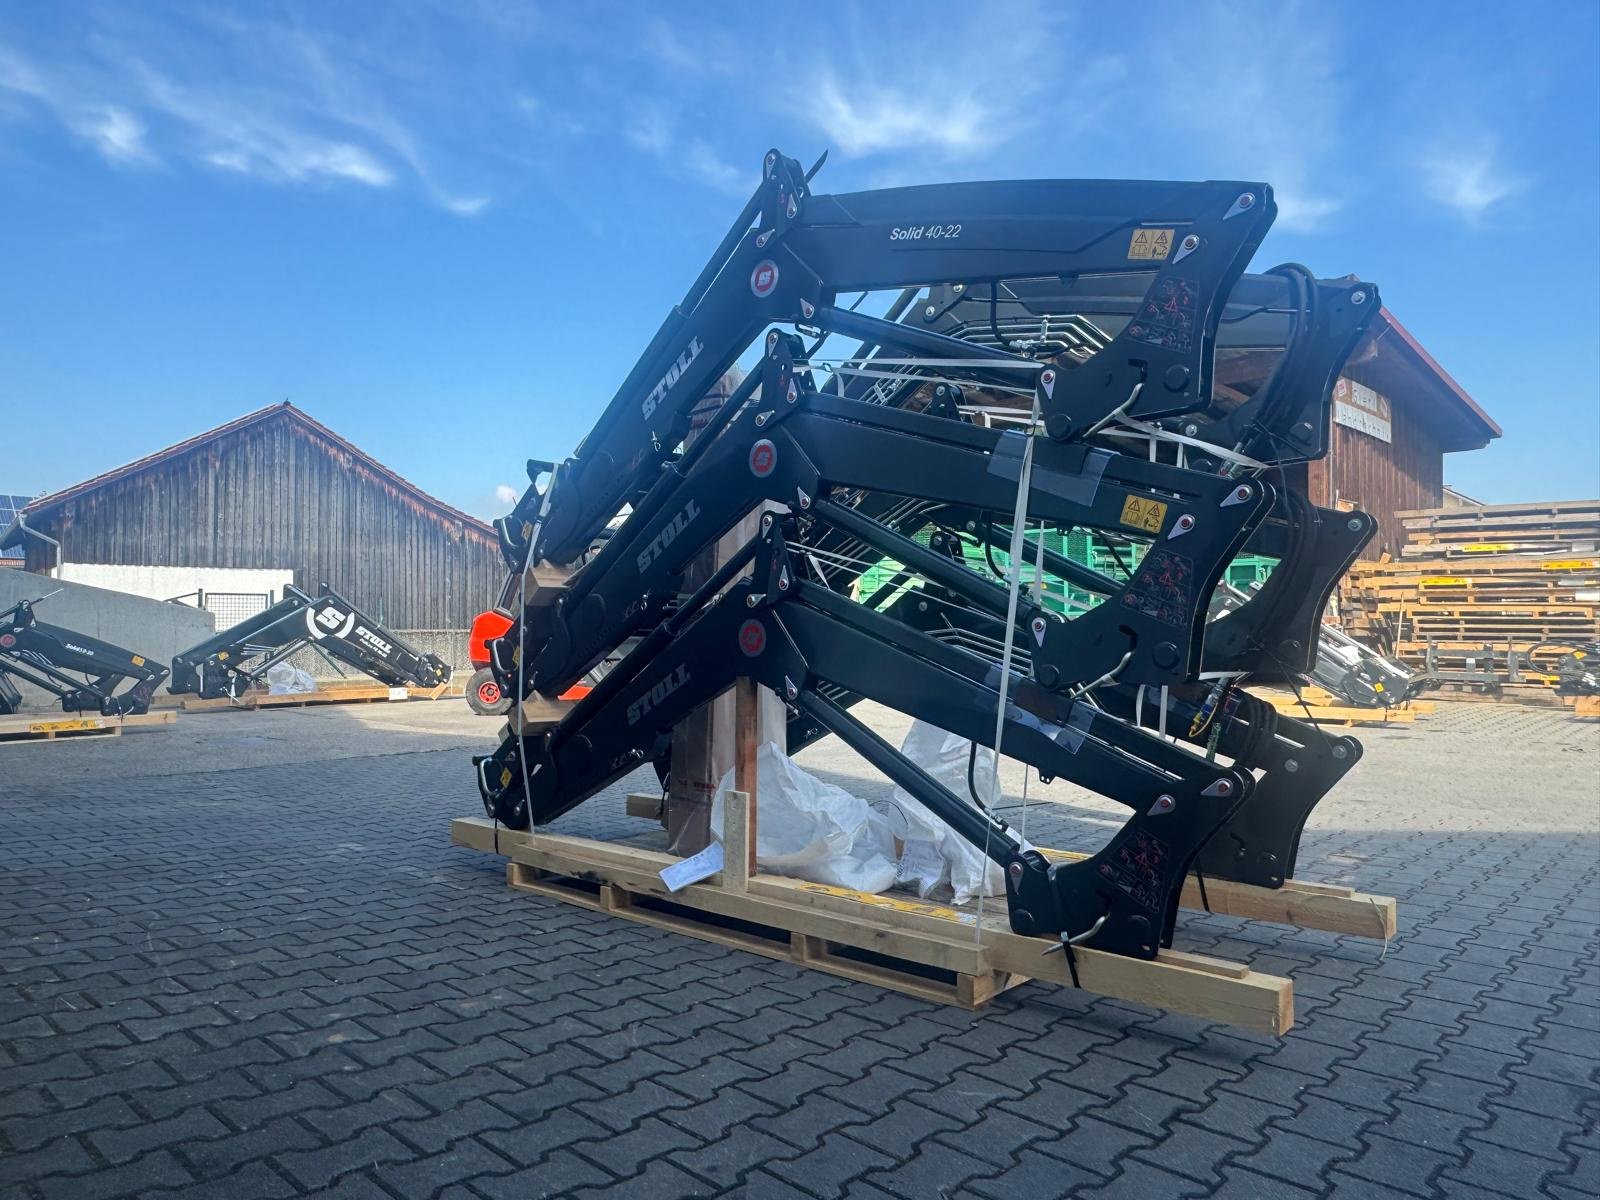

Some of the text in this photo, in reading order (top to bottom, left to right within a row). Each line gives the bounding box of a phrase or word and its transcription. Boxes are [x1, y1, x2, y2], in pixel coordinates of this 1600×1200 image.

[890, 224, 962, 240] Solid 40-22
[641, 335, 704, 421] STOLL
[637, 499, 701, 574] STOLL
[355, 625, 393, 653] STOLL
[626, 662, 691, 727] STOLL
